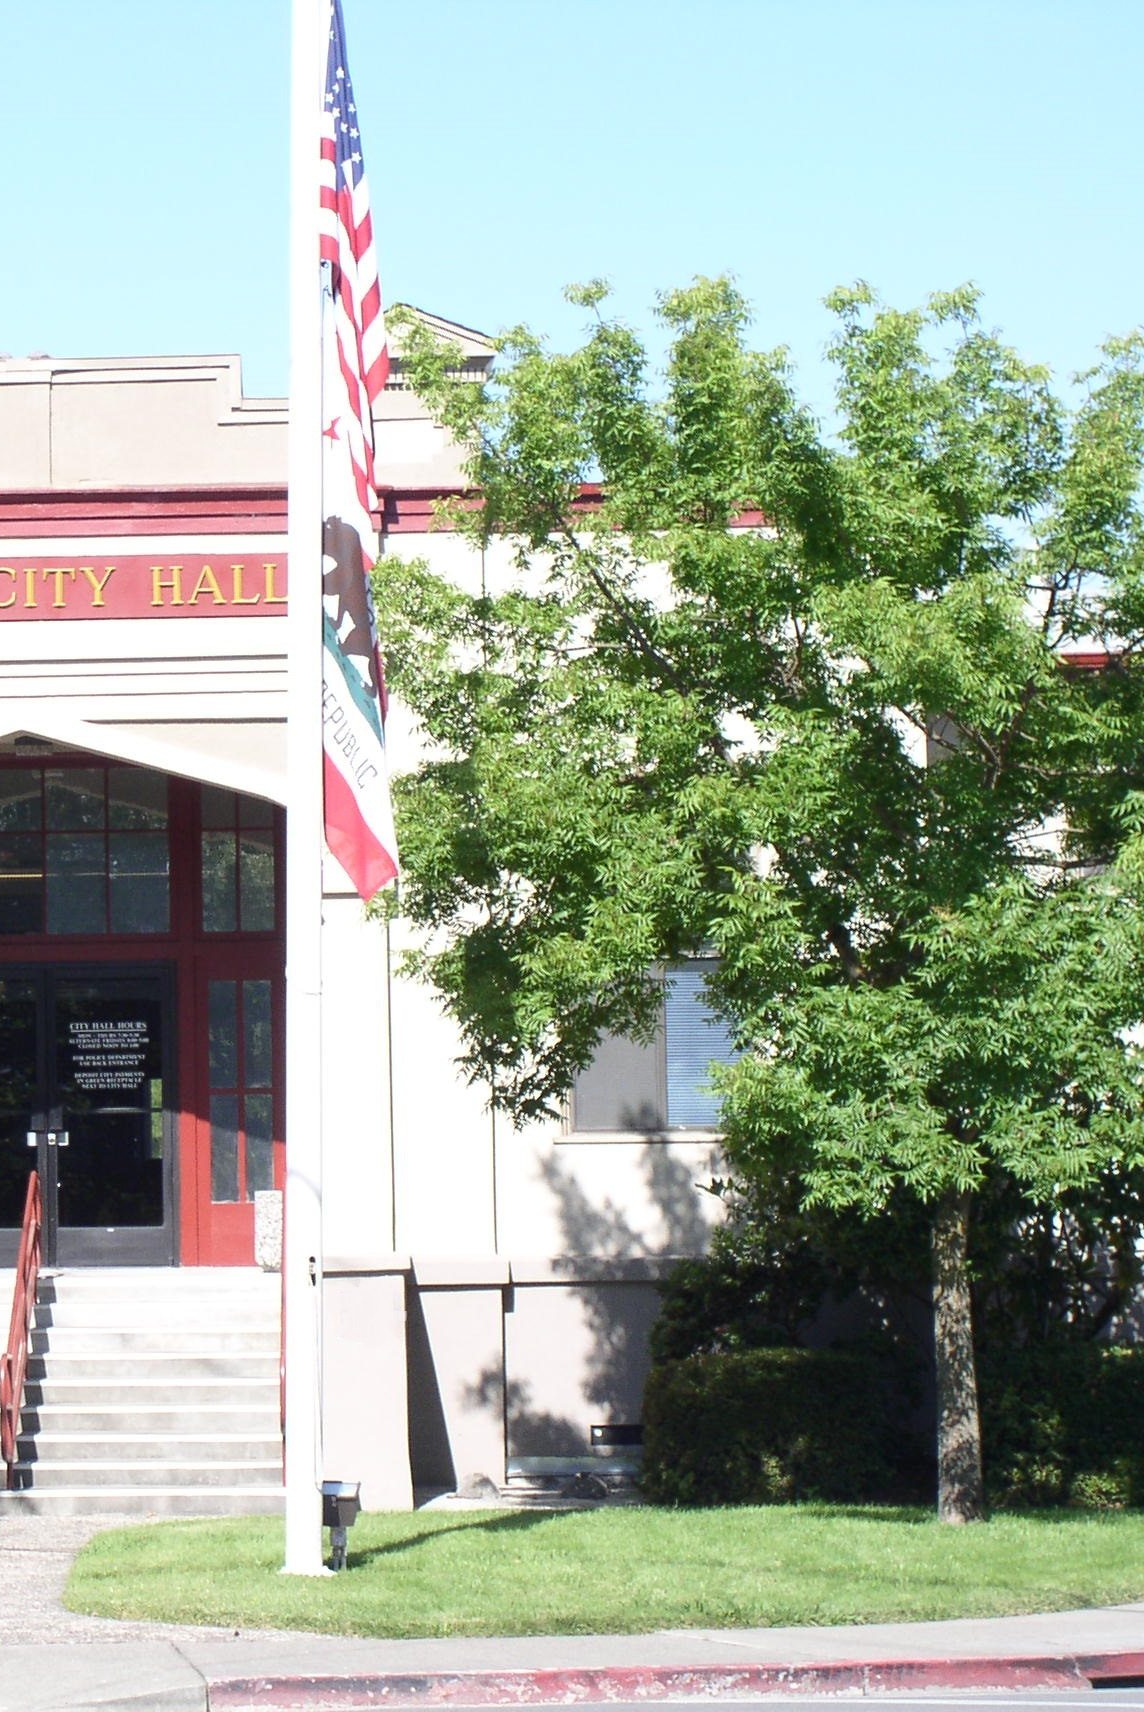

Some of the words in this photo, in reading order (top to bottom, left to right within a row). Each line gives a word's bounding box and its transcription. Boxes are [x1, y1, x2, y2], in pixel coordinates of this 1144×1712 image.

[150, 563, 288, 606] HALL
[69, 1022, 89, 1030] CITY
[92, 1022, 113, 1030] HALL
[118, 1022, 147, 1030] HOURS
